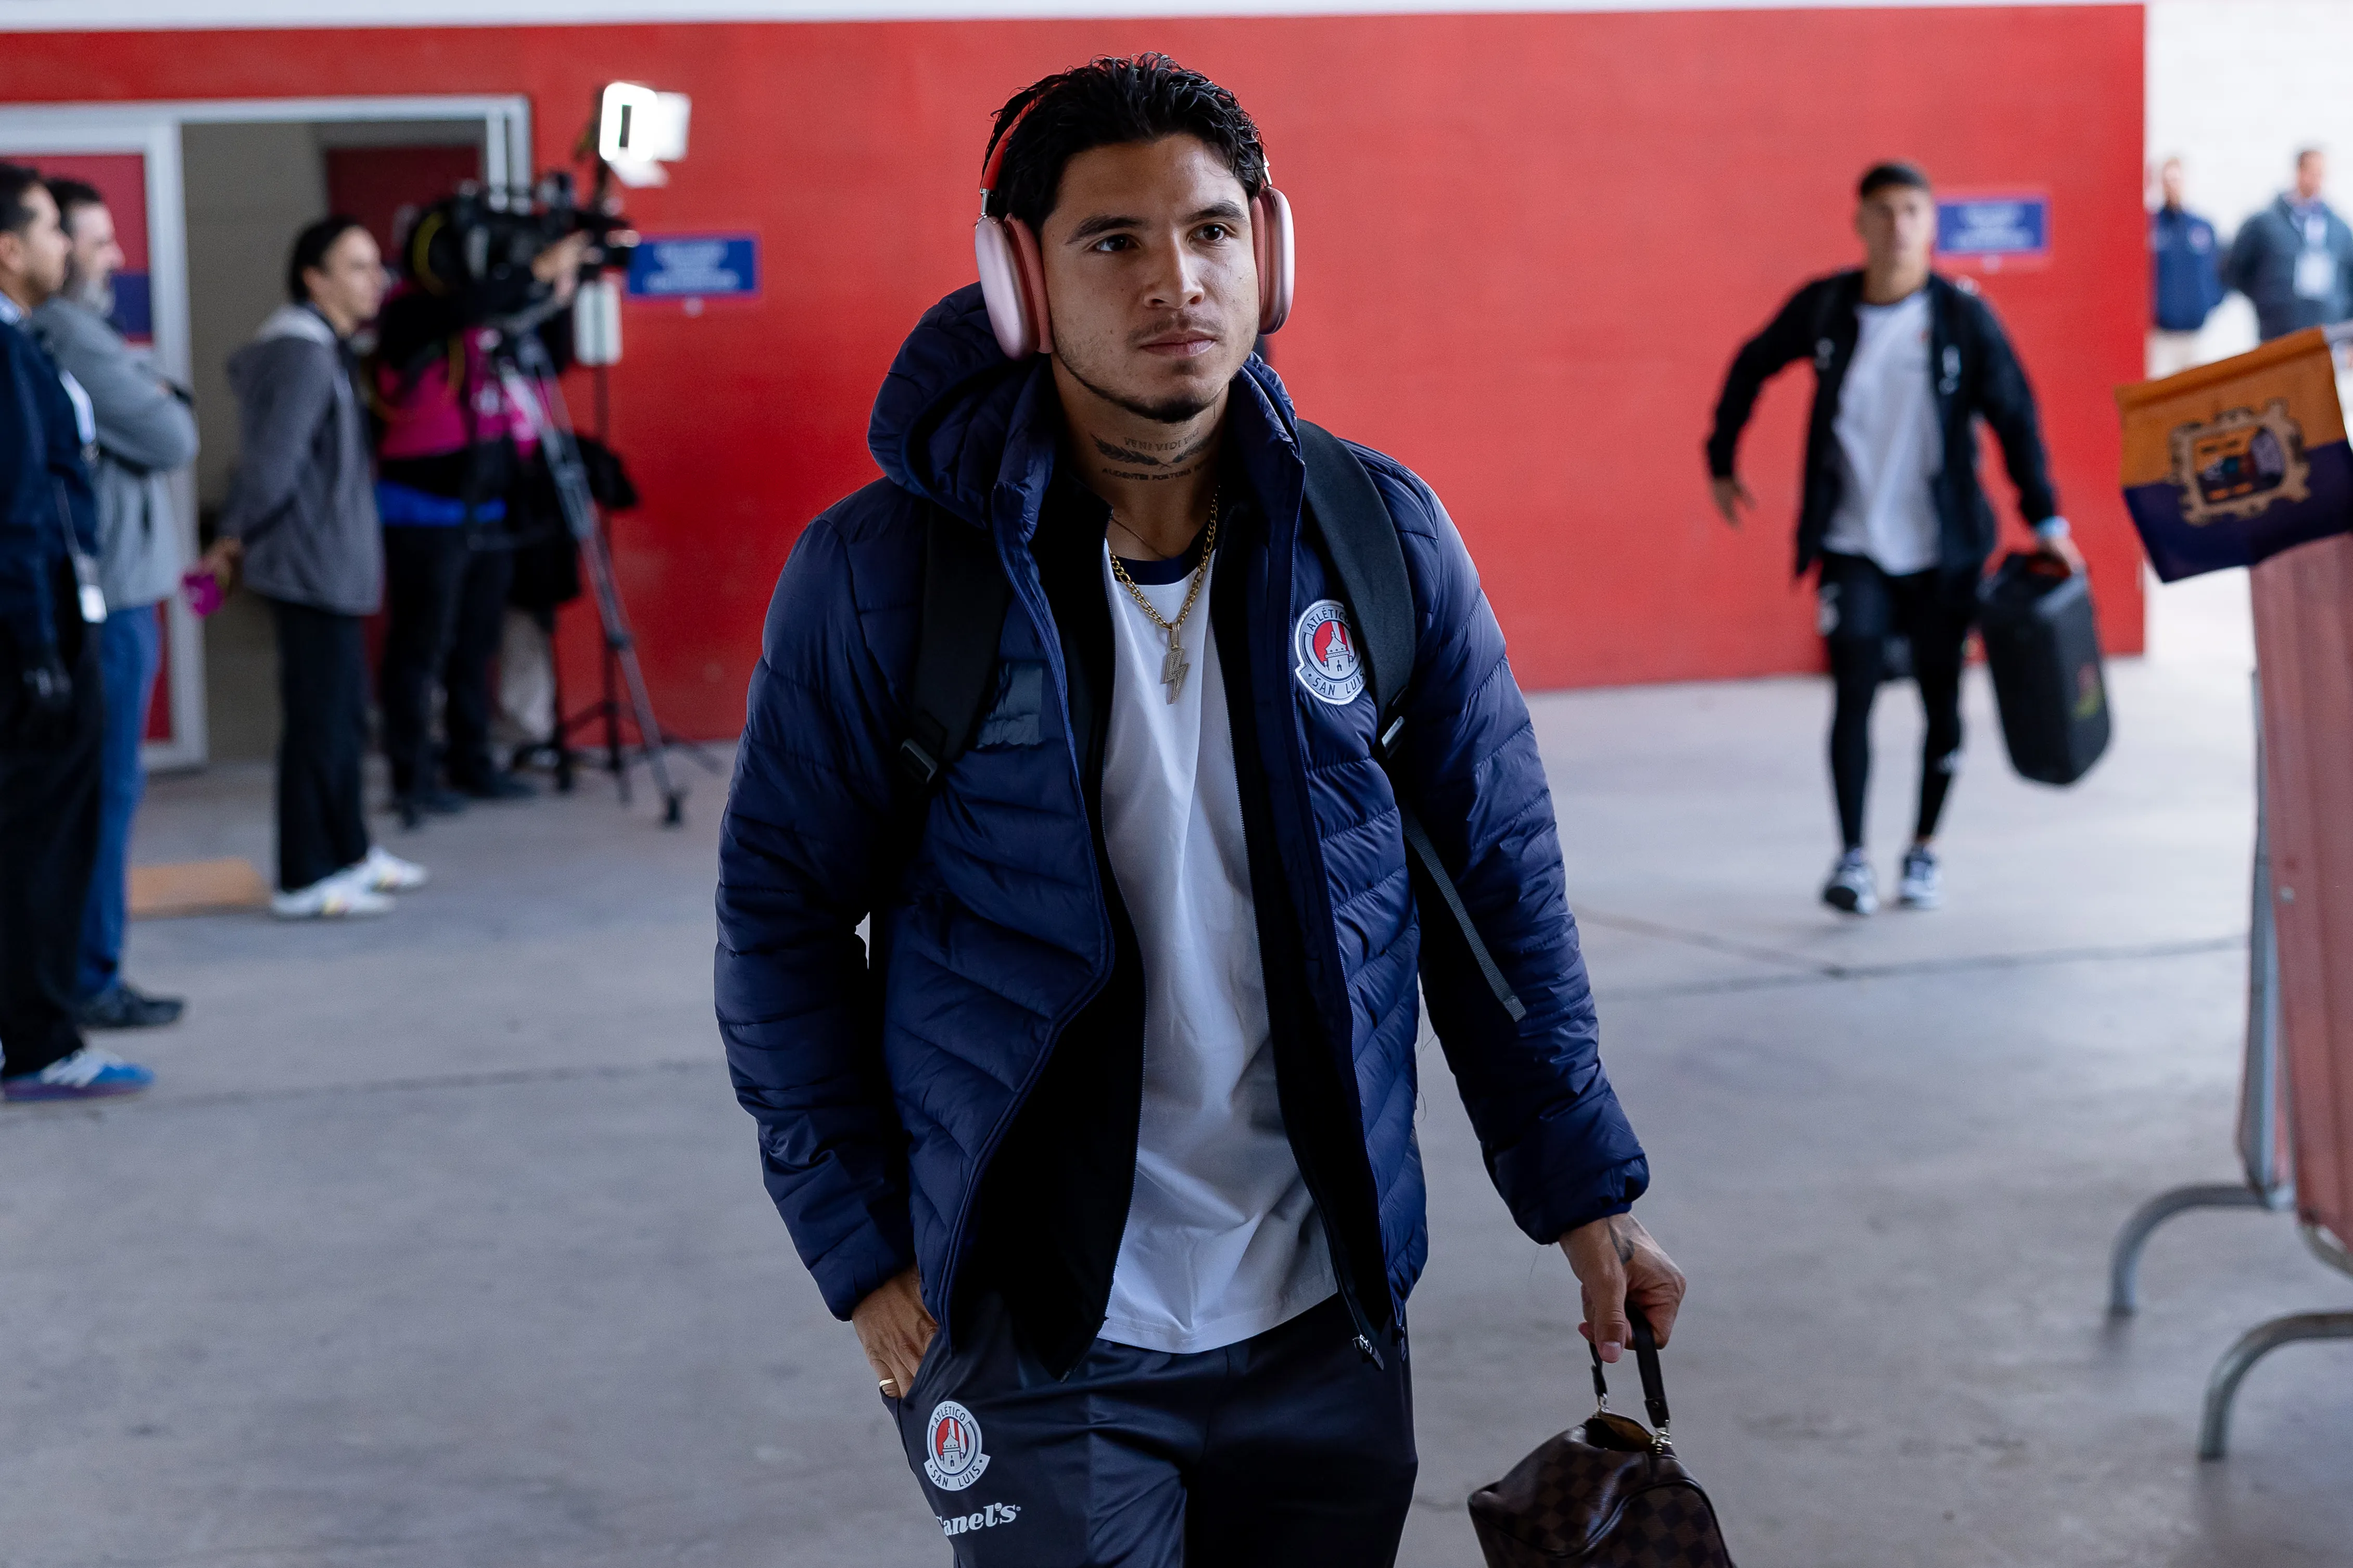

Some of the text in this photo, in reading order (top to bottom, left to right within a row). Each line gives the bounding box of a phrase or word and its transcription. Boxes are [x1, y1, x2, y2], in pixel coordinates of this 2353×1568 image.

[1155, 440, 1181, 451] VIDI
[1307, 607, 1349, 631] ATLÉTICO
[1312, 670, 1365, 696] SAN LUIS
[934, 1404, 966, 1425] ATLÉTICO
[931, 1467, 981, 1487] SAN LUIS
